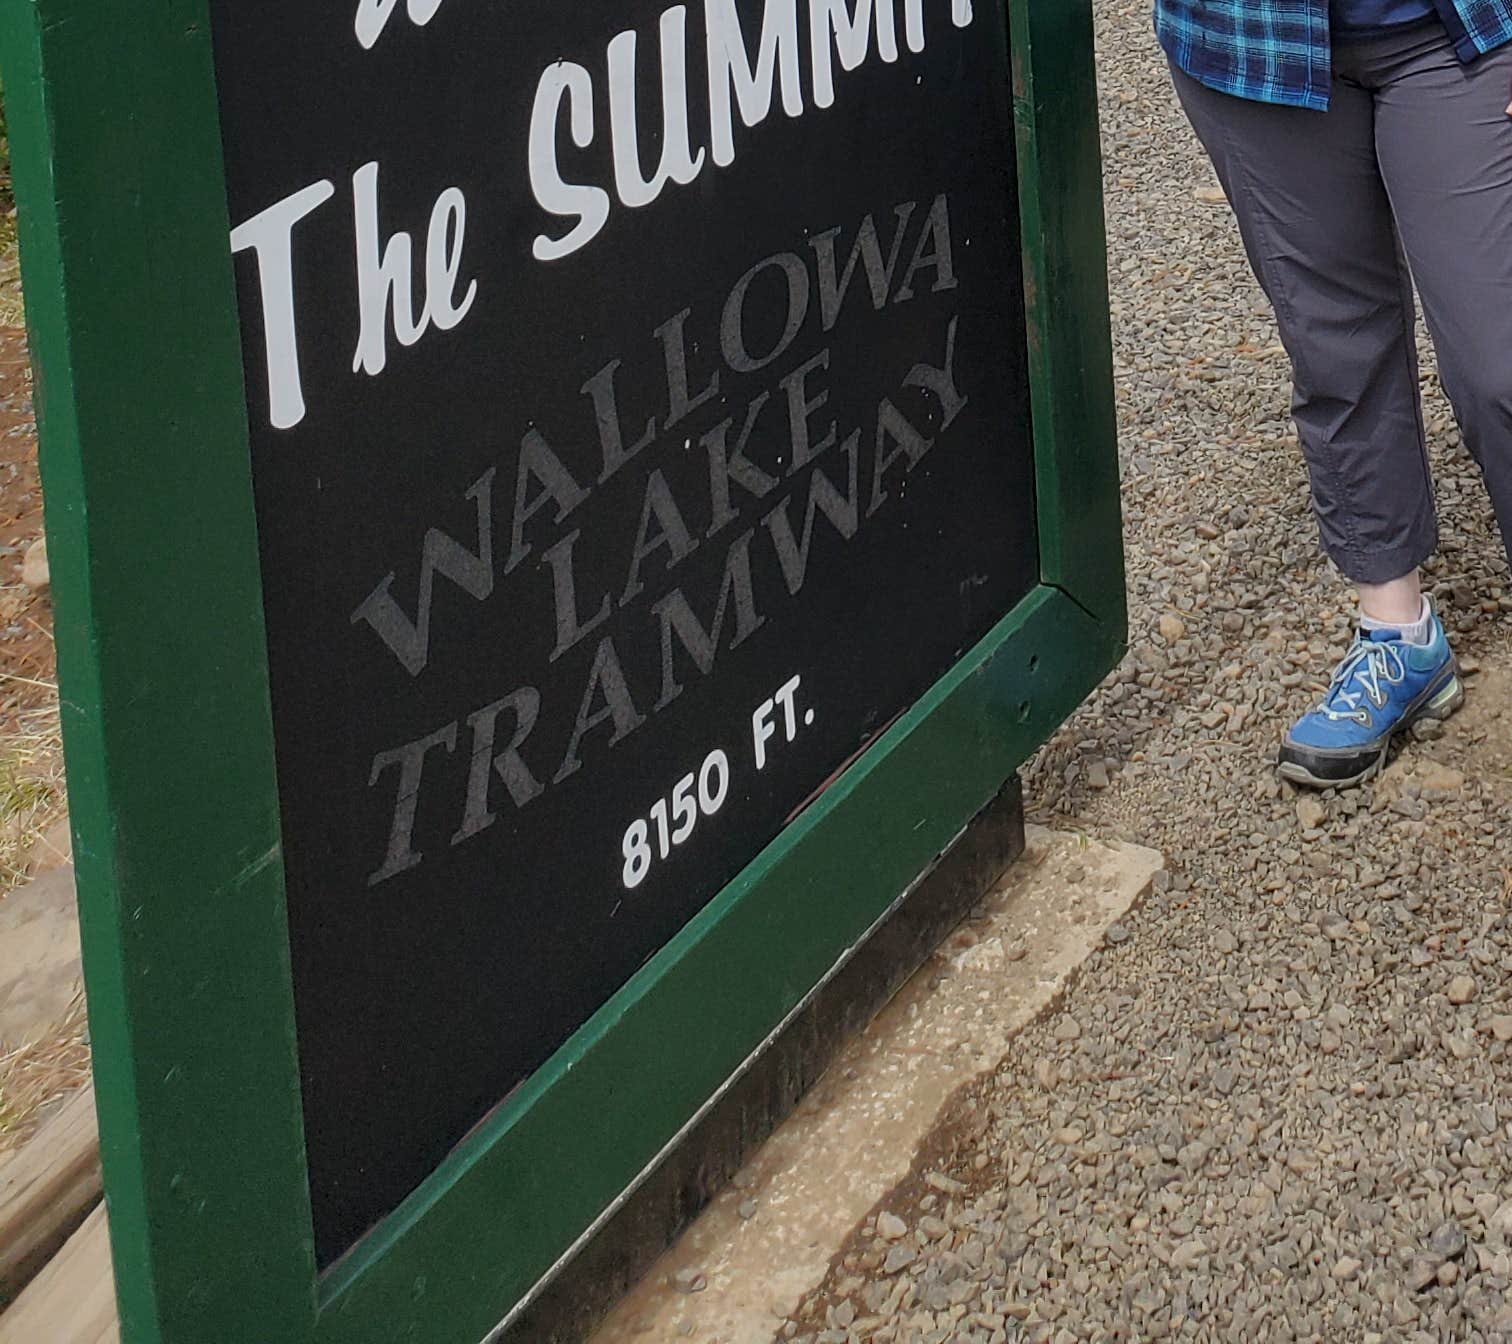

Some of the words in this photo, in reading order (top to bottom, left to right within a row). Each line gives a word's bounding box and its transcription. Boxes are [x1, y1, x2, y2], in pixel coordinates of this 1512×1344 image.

[230, 178, 478, 431] The
[350, 194, 960, 678] WALLOWA
[367, 315, 970, 888] TRAMWAY
[541, 347, 838, 664] LAKE
[621, 748, 730, 890] 8150
[751, 673, 816, 772] FT.
